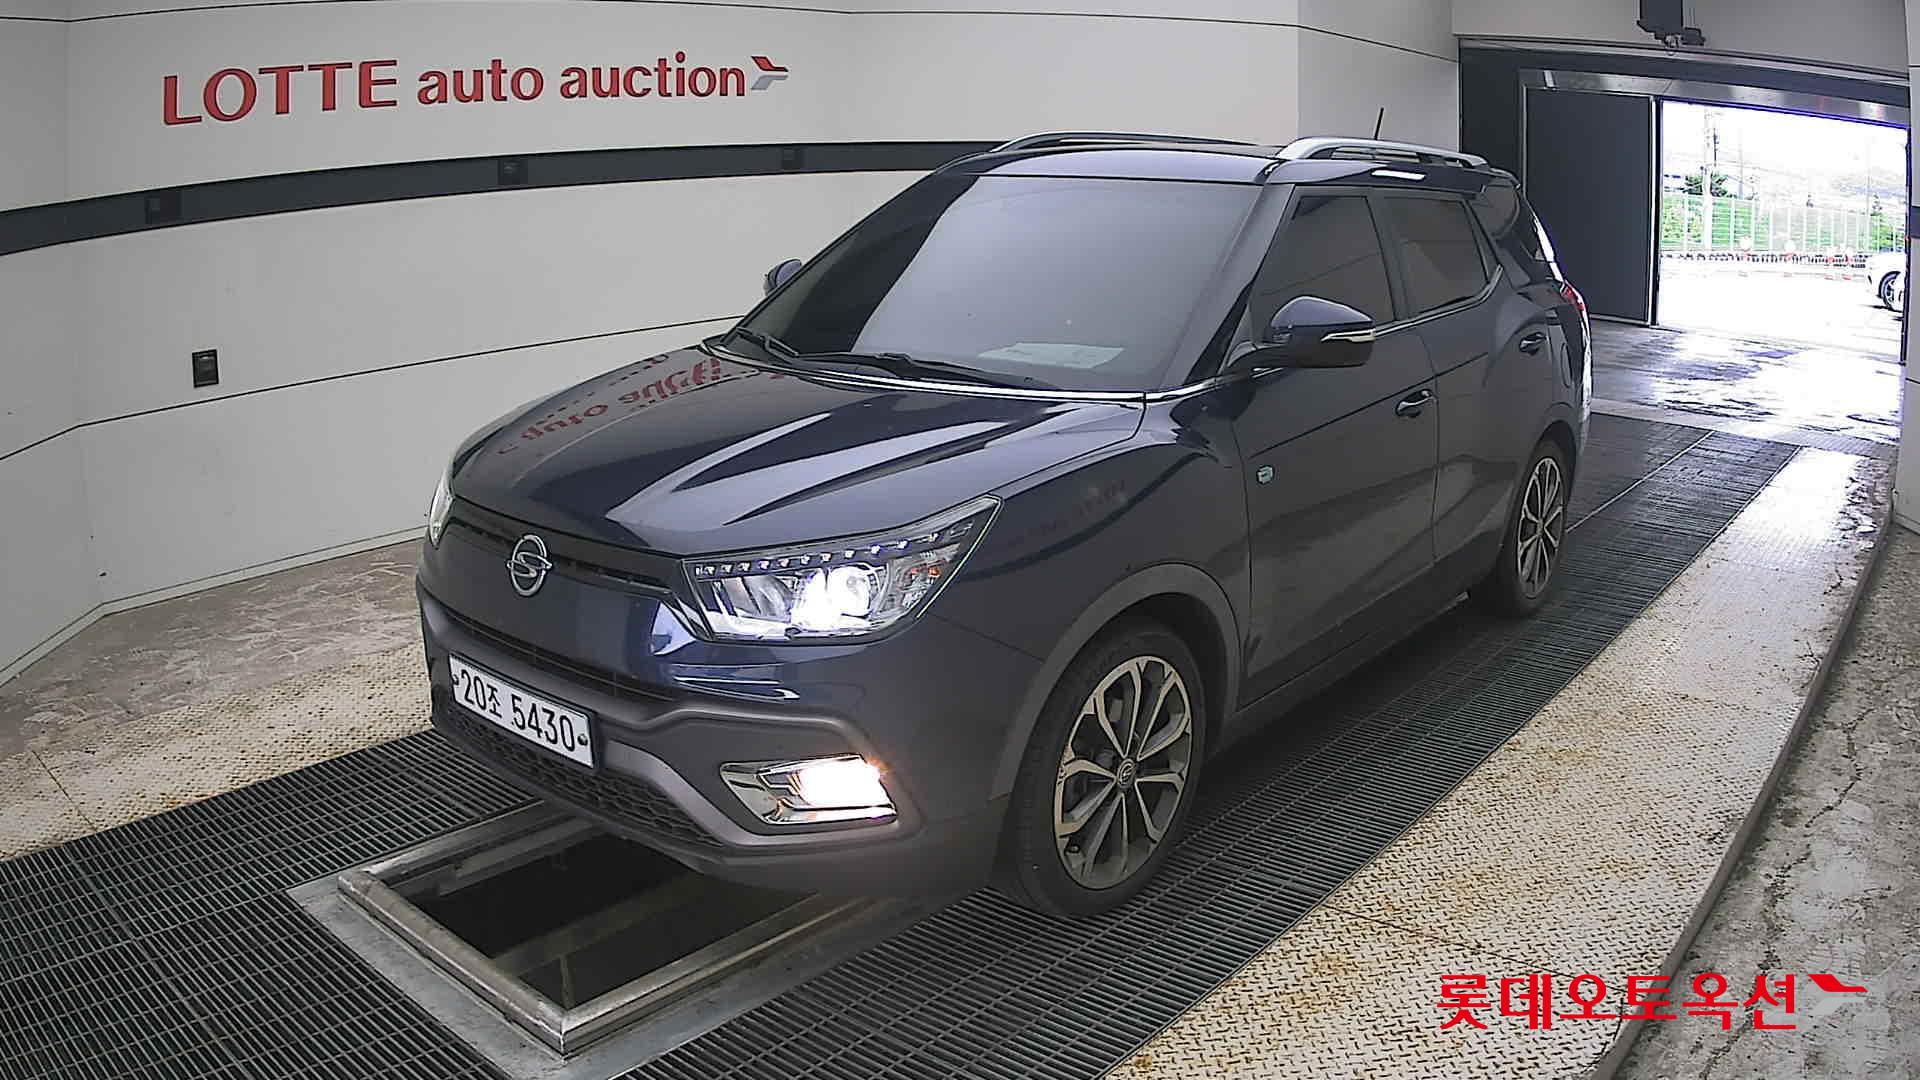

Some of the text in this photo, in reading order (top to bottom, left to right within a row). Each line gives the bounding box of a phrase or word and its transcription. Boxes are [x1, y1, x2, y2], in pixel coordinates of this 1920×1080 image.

[162, 52, 746, 126] LOTTE auto auction
[460, 668, 576, 752] 20조 5430
